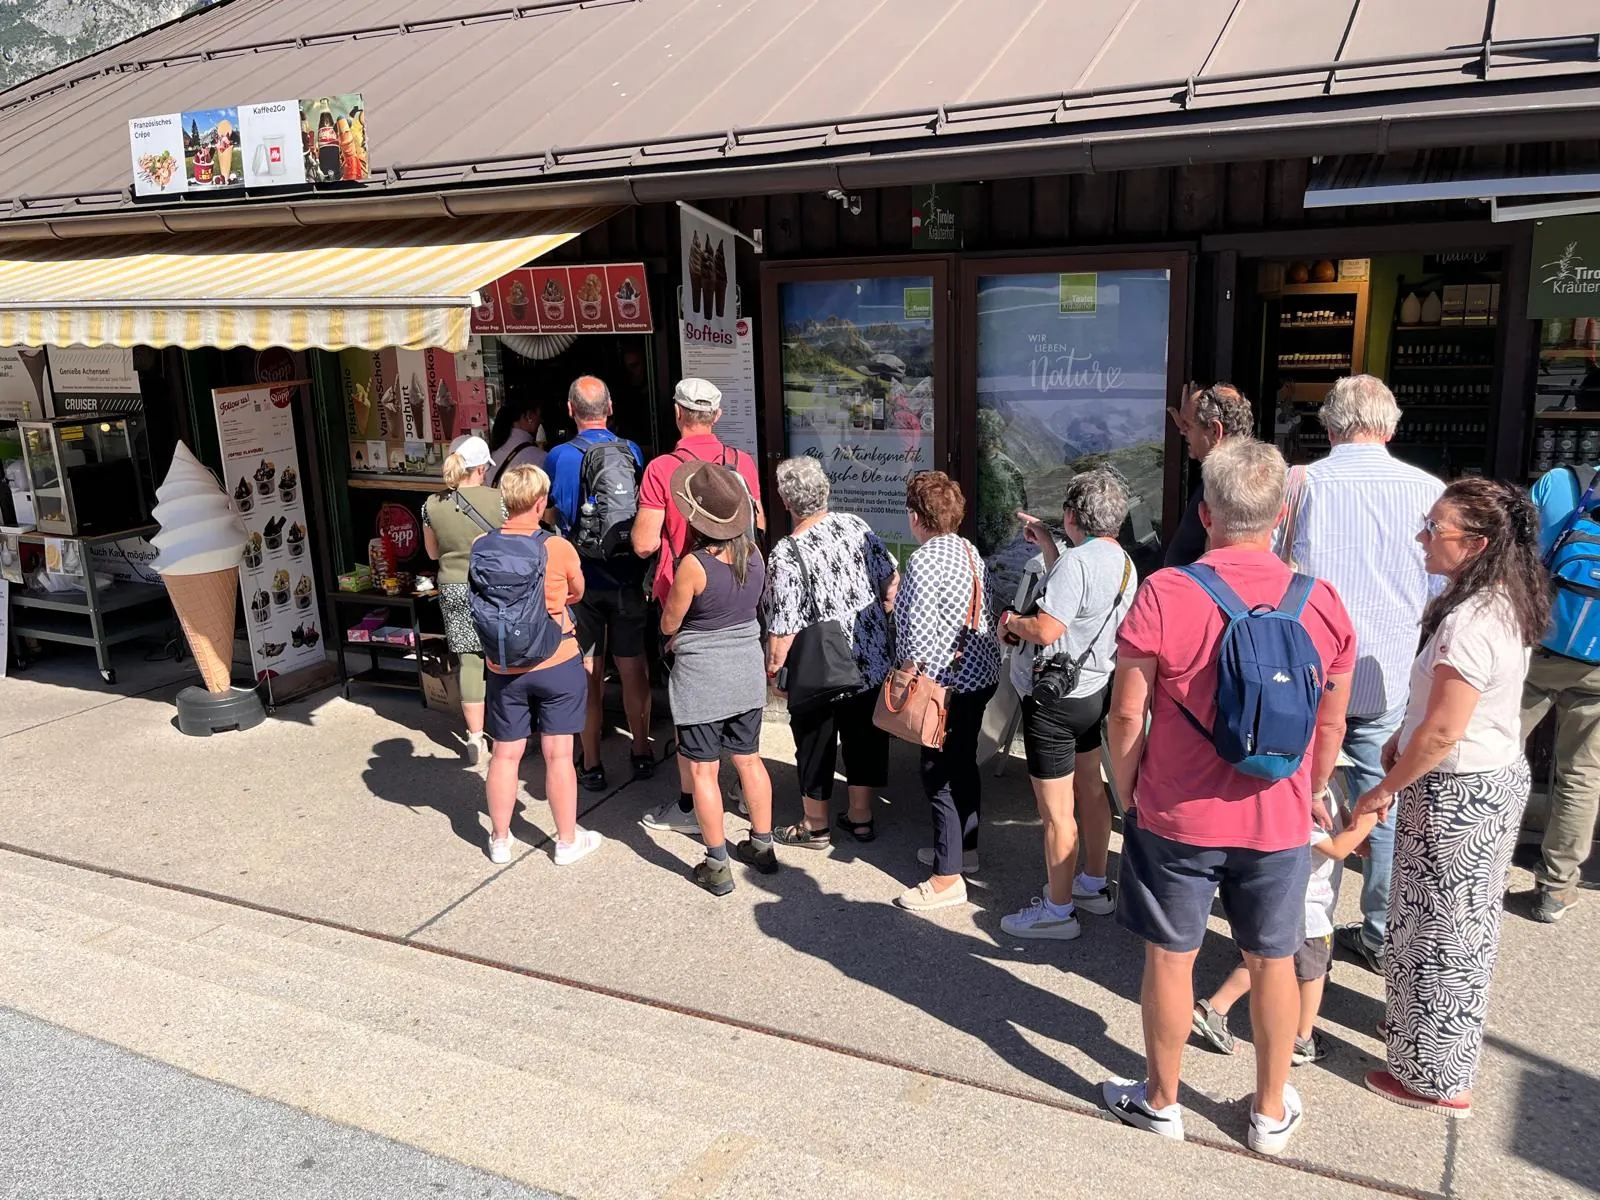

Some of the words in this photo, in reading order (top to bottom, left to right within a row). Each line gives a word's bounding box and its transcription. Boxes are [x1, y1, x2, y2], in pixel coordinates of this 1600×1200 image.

[252, 104, 286, 115] Kaffee2Go
[133, 118, 172, 129] Französisches
[134, 130, 151, 139] Crêpe
[686, 322, 733, 344] Softeis
[1028, 334, 1047, 342] WIR
[1034, 343, 1067, 352] LIEBEN
[270, 390, 290, 403] Stopp
[64, 398, 98, 411] CRUISER
[220, 399, 239, 415] Follow
[402, 385, 414, 438] Joghurt
[878, 489, 906, 497] Produktio
